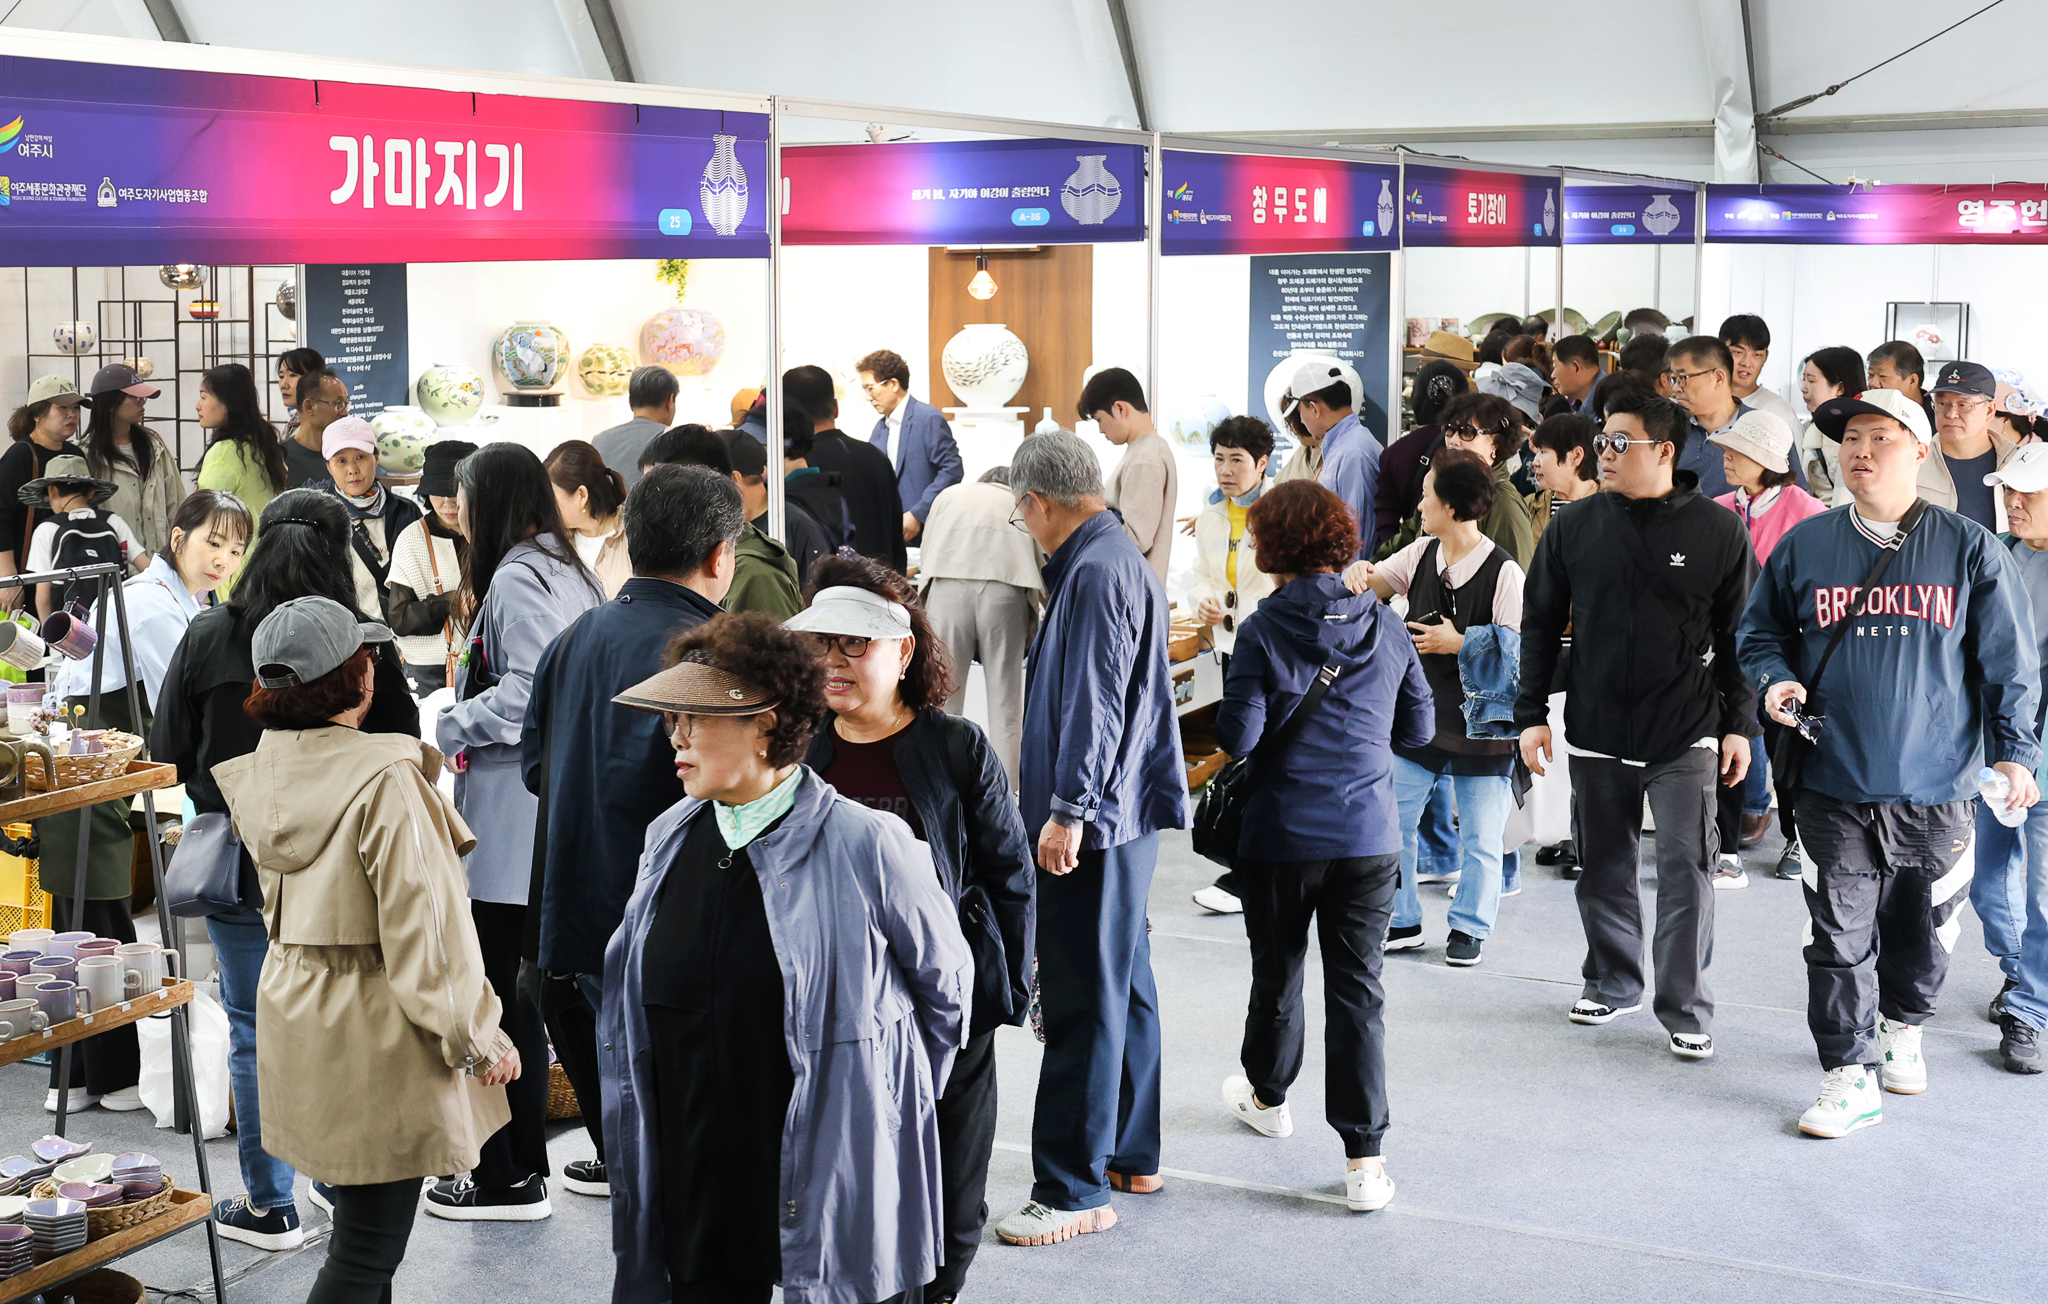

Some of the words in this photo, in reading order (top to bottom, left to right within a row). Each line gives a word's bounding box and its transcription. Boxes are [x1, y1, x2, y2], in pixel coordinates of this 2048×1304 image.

[18, 143, 53, 158] 여주시
[329, 135, 523, 211] 가마지기
[11, 182, 87, 197] 여주세종문화관광재단
[118, 187, 208, 203] 여주도자기사업협동조합
[949, 187, 978, 200] 자기야
[980, 187, 1009, 199] 여강이
[1011, 186, 1050, 198] 출렁인다
[1467, 192, 1507, 225] 토기장이
[670, 215, 681, 229] 25
[1019, 212, 1042, 222] A-36
[1815, 584, 1955, 630] BROOKLYN
[1856, 625, 1909, 637] NETS
